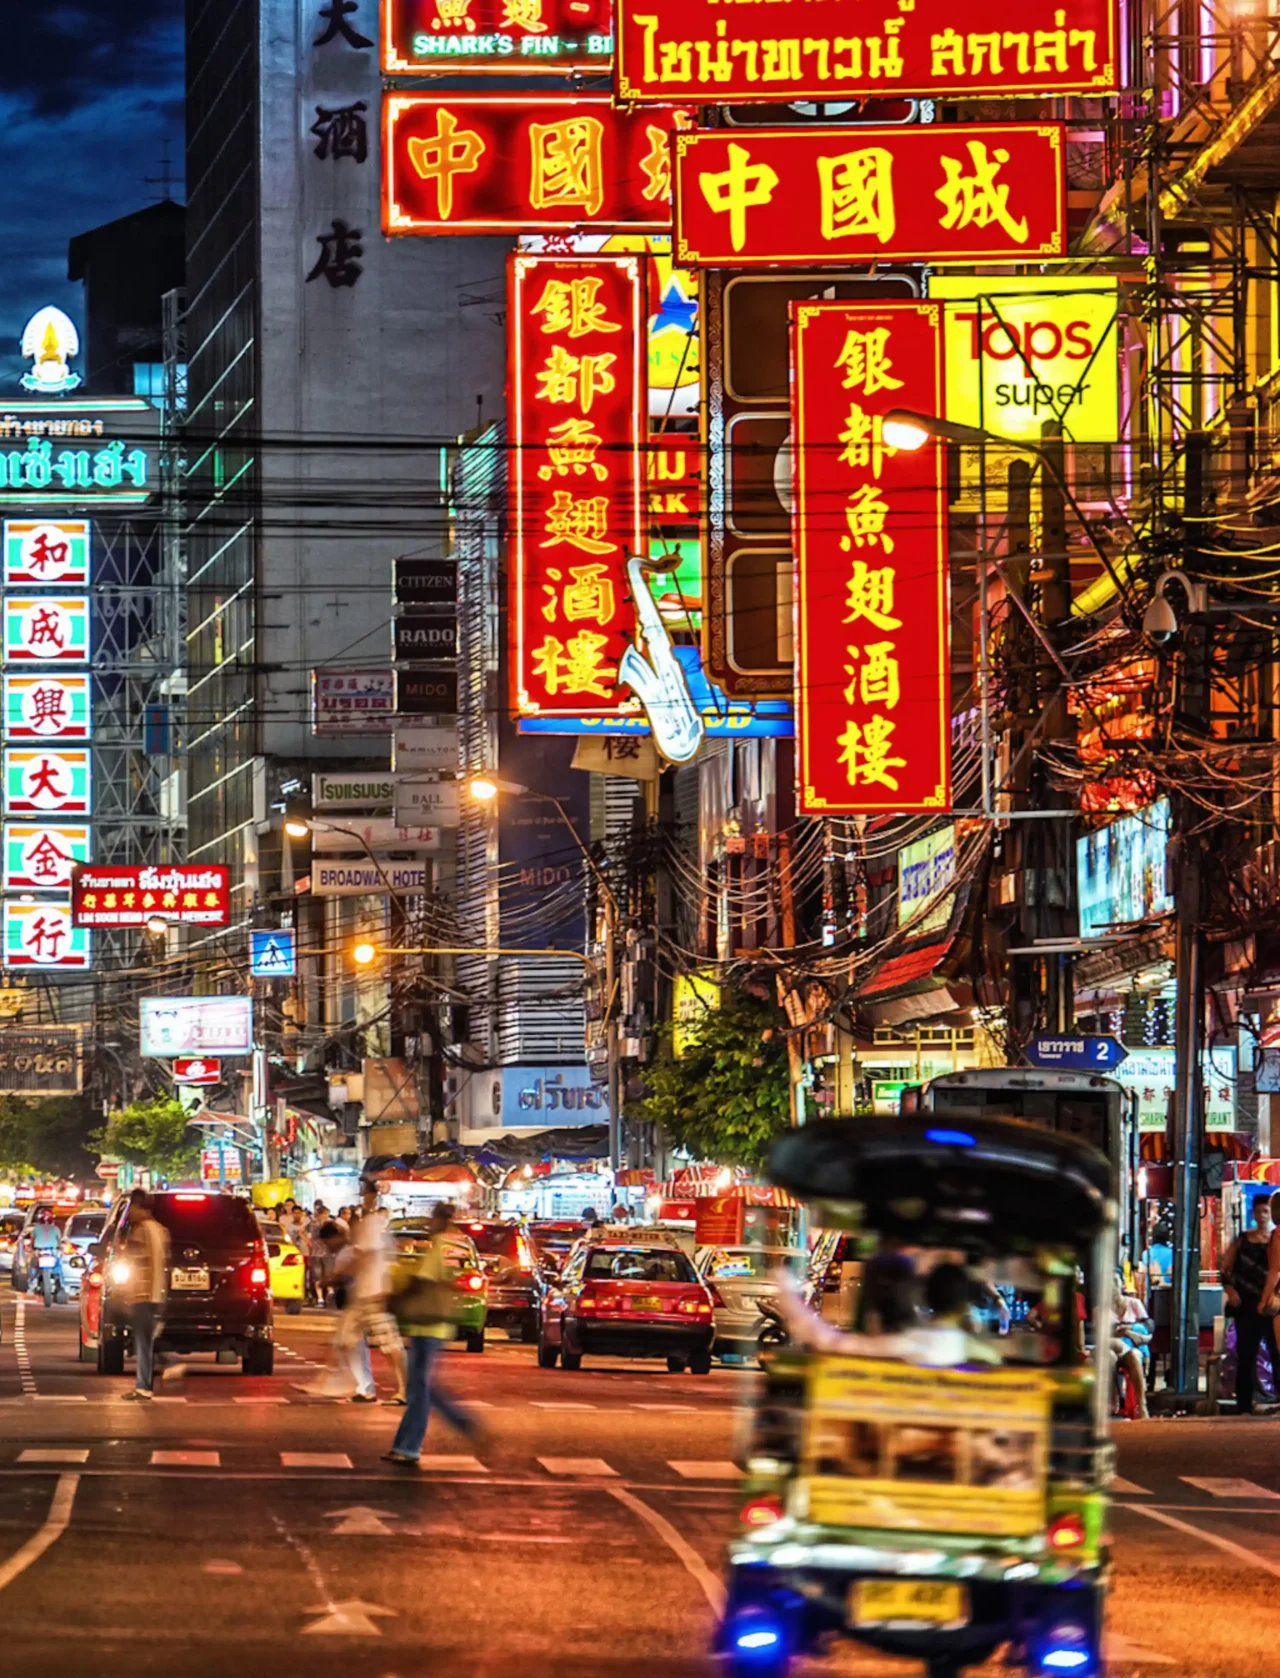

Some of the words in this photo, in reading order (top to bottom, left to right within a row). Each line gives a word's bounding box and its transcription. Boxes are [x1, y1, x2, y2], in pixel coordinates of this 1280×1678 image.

[413, 33, 513, 54] SHARK'S
[520, 35, 559, 54] FIN
[633, 14, 905, 84] ไชน่าทาวน์
[930, 9, 1097, 77] สกาล่า
[699, 140, 1030, 252] 中國城
[954, 311, 1094, 368] Tops
[995, 381, 1092, 424] super
[530, 276, 622, 698] 銀都魚翅酒樓
[833, 326, 907, 792] 銀都魚翅酒樓
[398, 575, 453, 588] CITIZEN
[399, 629, 454, 643] RADO
[405, 684, 448, 696] MIDO
[27, 533, 69, 960] 和成興大金行
[320, 777, 394, 800] โรงแรมบร
[320, 870, 389, 887] BROADWAY
[392, 870, 426, 886] HOTE
[1096, 1042, 1109, 1061] 2
